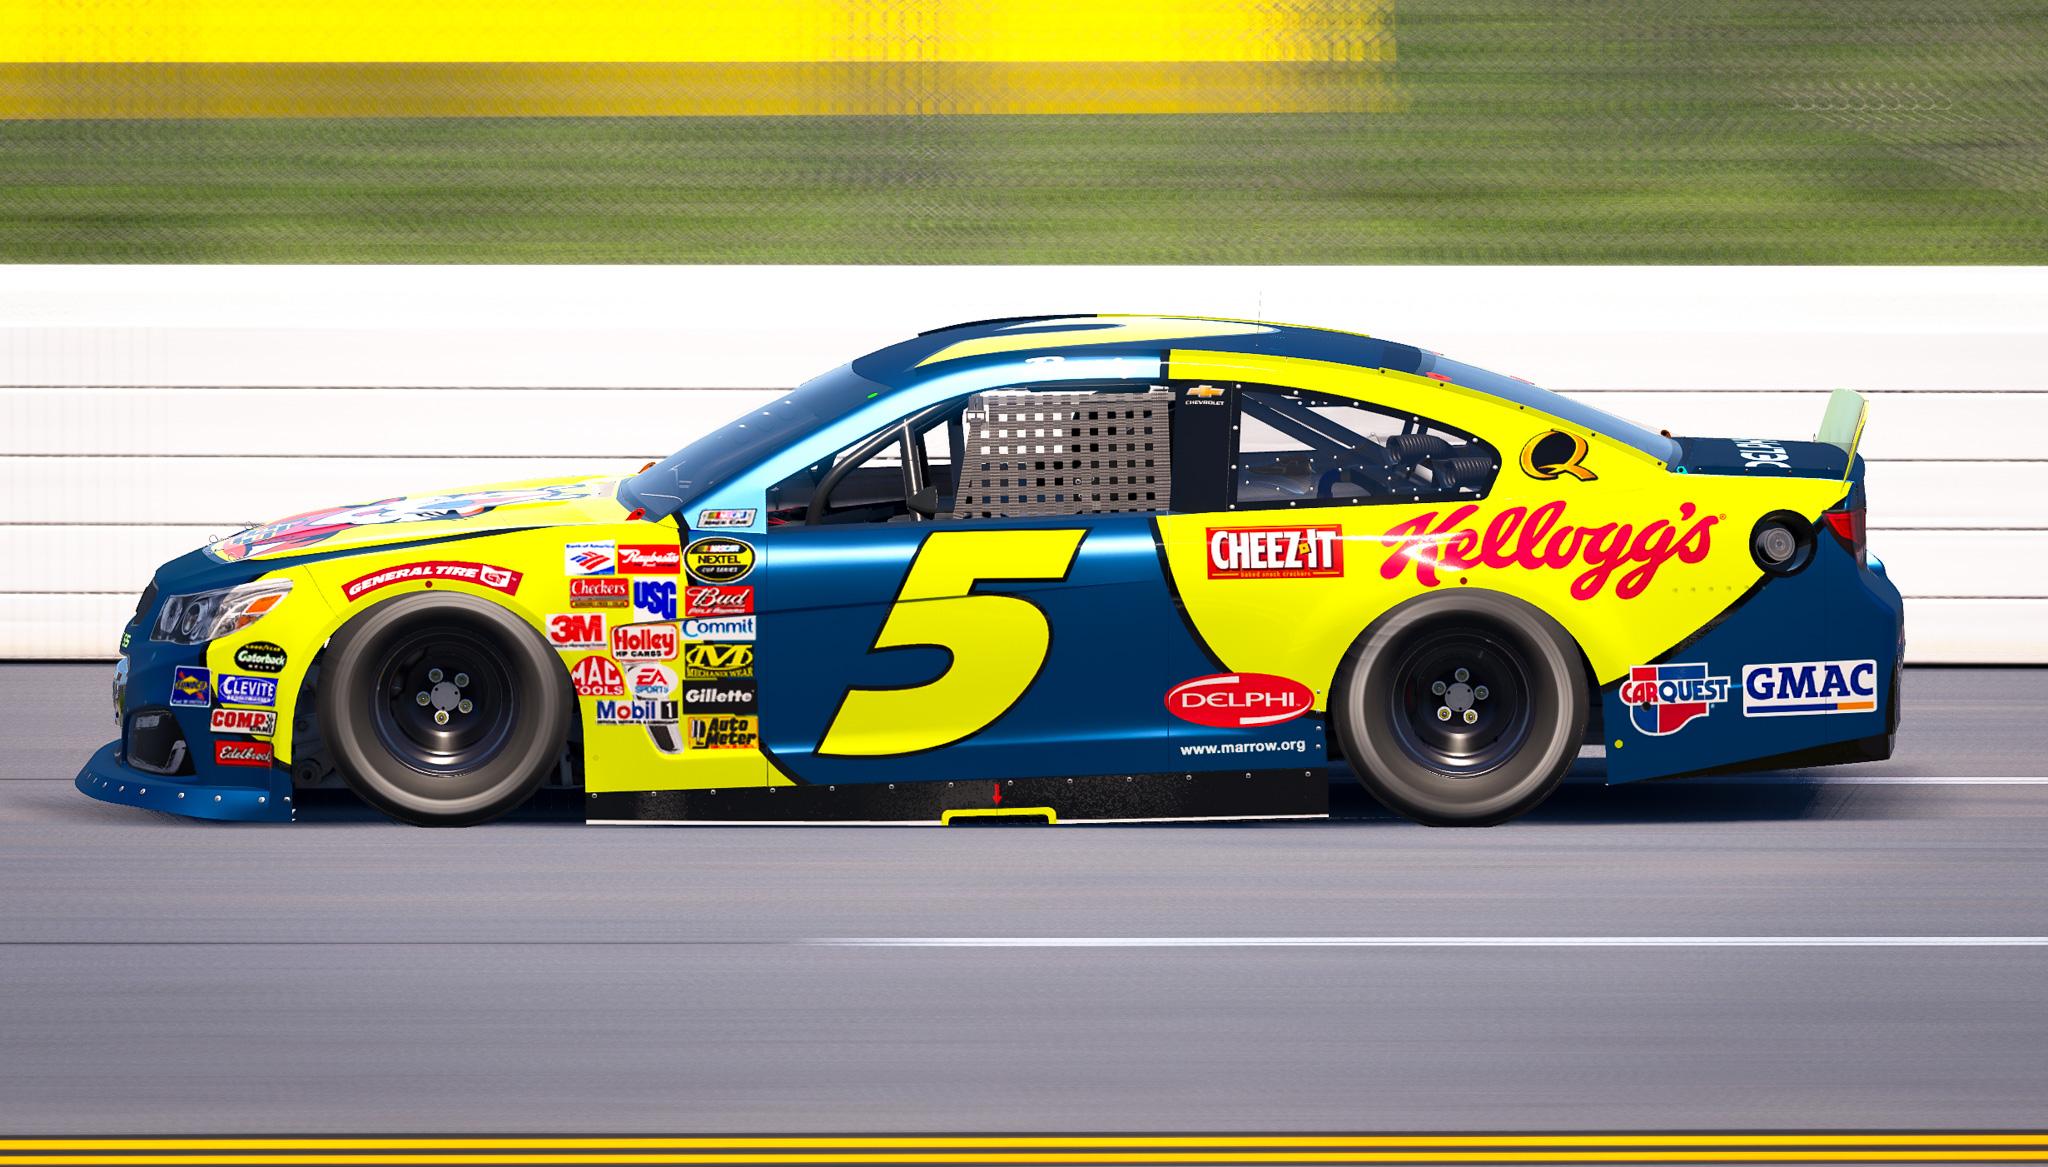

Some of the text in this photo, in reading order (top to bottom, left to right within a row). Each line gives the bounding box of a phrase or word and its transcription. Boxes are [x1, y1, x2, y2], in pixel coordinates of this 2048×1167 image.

[1519, 428, 1598, 481] Q
[697, 555, 741, 564] NEXTEL
[1380, 500, 1719, 601] Kellogg's
[349, 565, 480, 596] GENERAL TIRE
[571, 580, 626, 595] Checkers
[634, 581, 677, 620] USG
[687, 588, 751, 608] Bud
[551, 615, 603, 643] 3M
[682, 617, 753, 638] Commit
[614, 629, 675, 656] Holley
[812, 527, 1092, 760] 5
[238, 650, 286, 665] Gatorback
[223, 676, 274, 697] CLEVITE
[635, 668, 668, 686] EA
[1746, 663, 1874, 701] GMAC
[685, 688, 752, 703] Gillette
[1181, 692, 1295, 708] DELPHI
[1620, 679, 1729, 704] CARQUEST
[212, 710, 266, 729] COMP
[596, 701, 656, 719] Mobil
[709, 717, 749, 732] Auto
[1180, 739, 1306, 756] www.marrow.org
